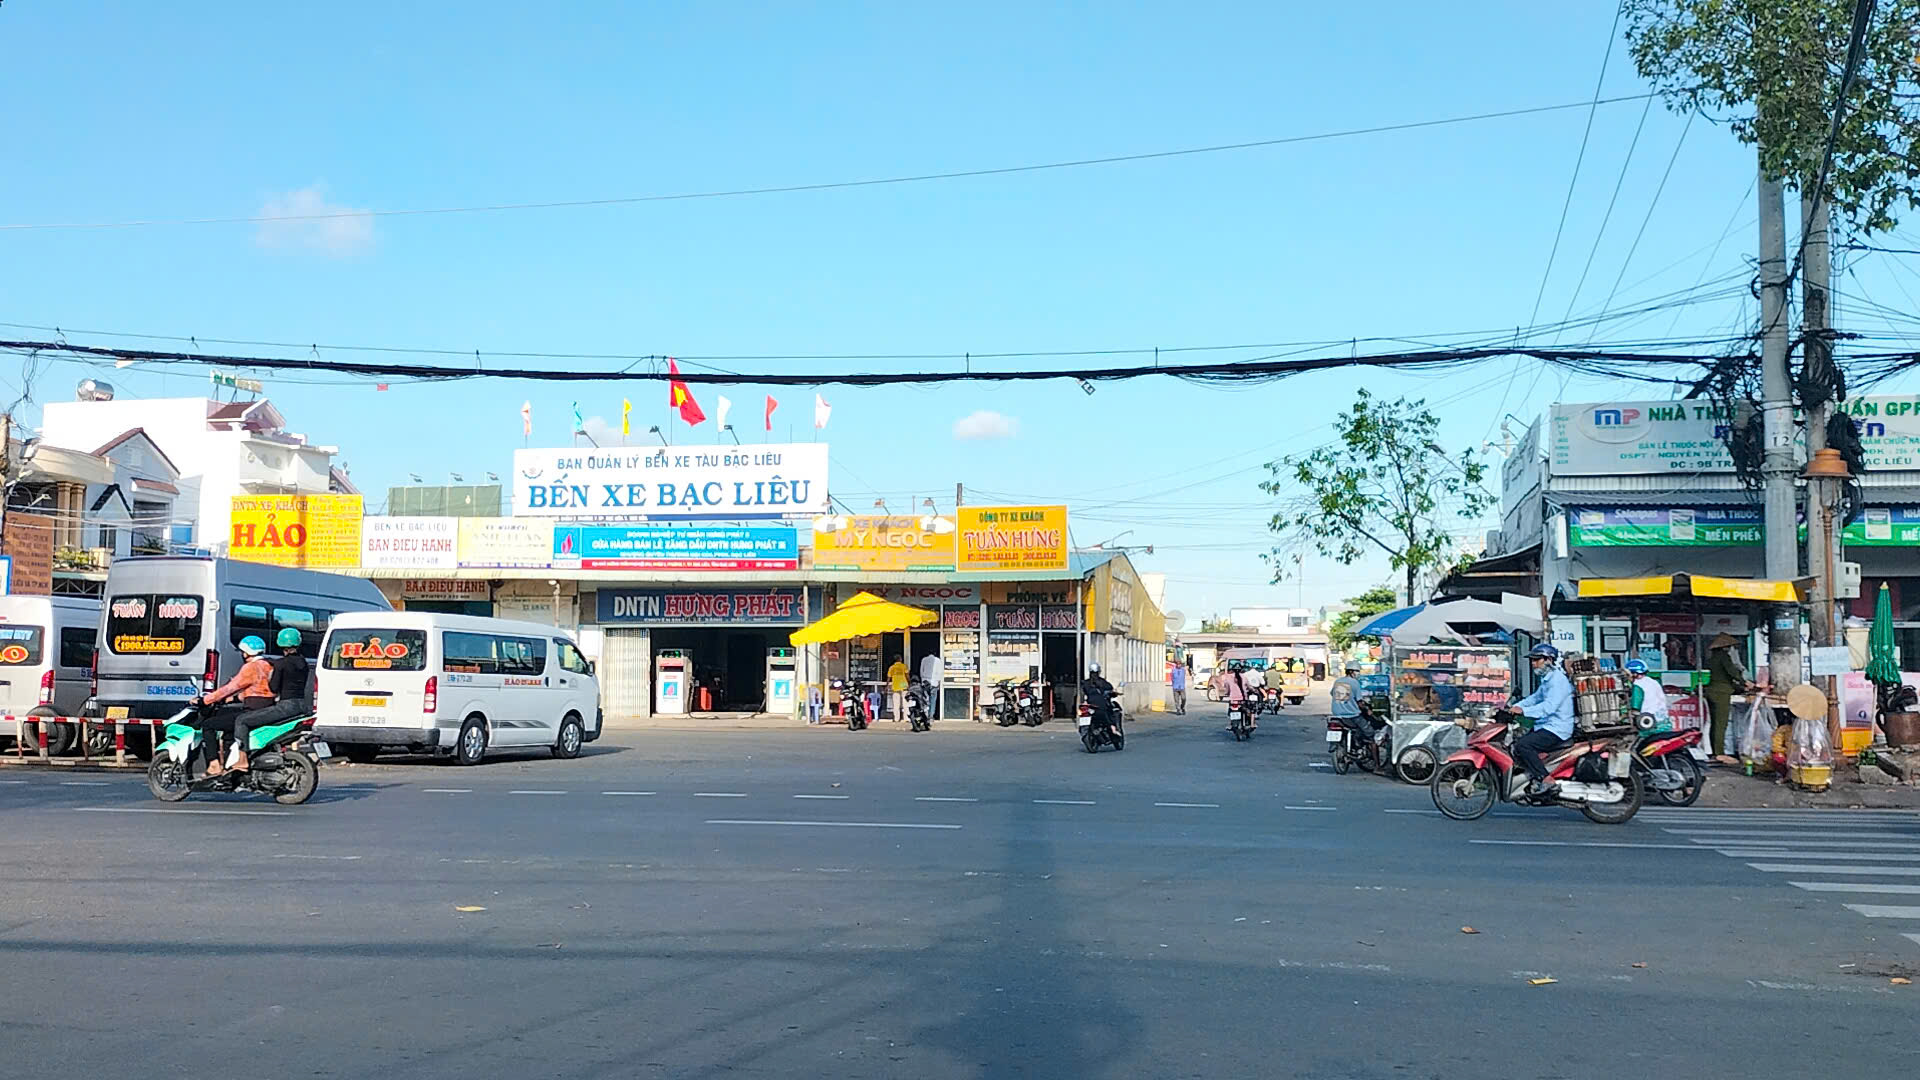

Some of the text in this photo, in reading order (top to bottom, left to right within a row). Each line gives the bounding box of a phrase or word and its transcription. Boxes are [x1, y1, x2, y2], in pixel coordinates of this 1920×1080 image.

[1648, 404, 1687, 422] NHÀ
[674, 455, 690, 468] XE
[528, 473, 812, 511] BẾN XE BẠC LIÊU
[232, 513, 308, 548] HẢO
[871, 531, 935, 552] NGỌC
[963, 523, 1061, 550] TUẤN HƯNG
[613, 596, 660, 617] DNTN
[664, 592, 731, 617] HƯNG
[734, 588, 794, 617] PHÁT
[900, 587, 973, 600] NGỌC
[995, 606, 1037, 629] TUẤN
[0, 645, 30, 664] O
[340, 637, 409, 659] HẢO
